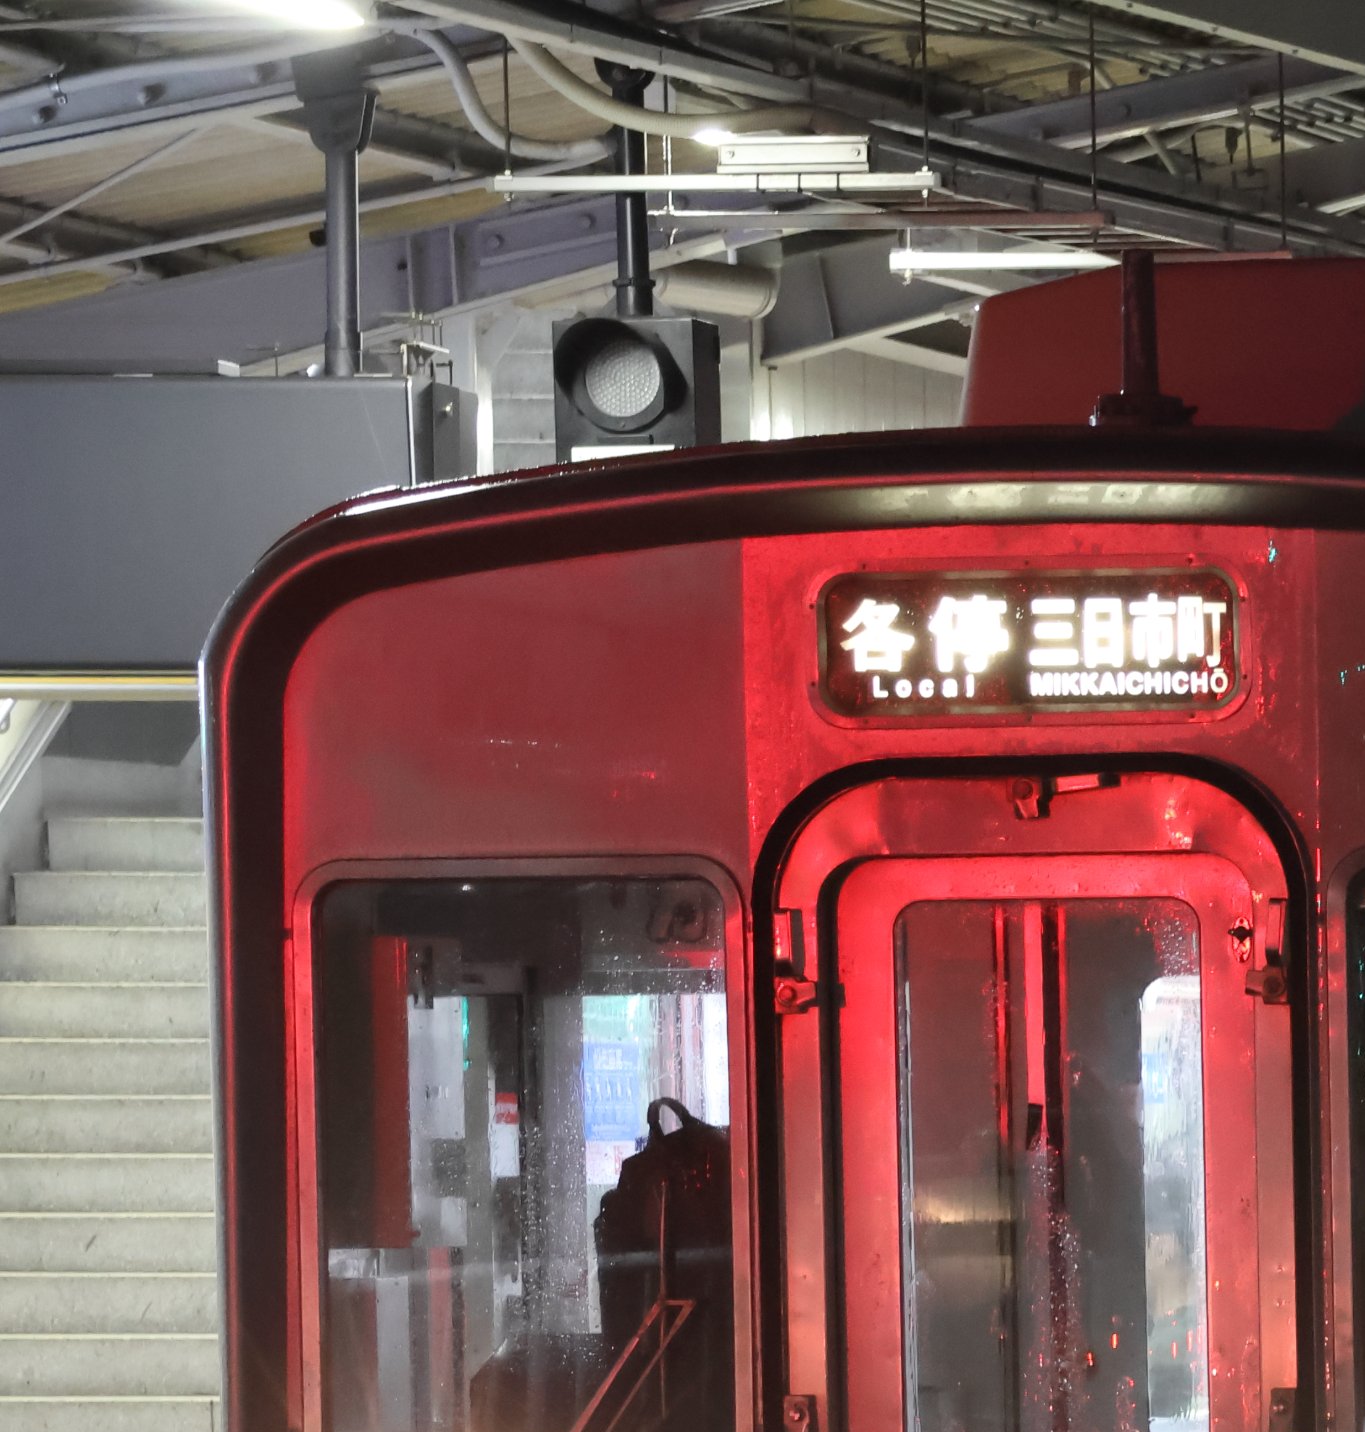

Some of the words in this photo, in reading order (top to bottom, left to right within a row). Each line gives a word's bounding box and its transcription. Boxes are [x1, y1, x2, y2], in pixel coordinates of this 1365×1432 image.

[840, 596, 1009, 673] 各停
[1029, 593, 1228, 668] 三日市町
[872, 676, 976, 699] Local
[1028, 668, 1230, 697] MIKKAICHICHŌ
